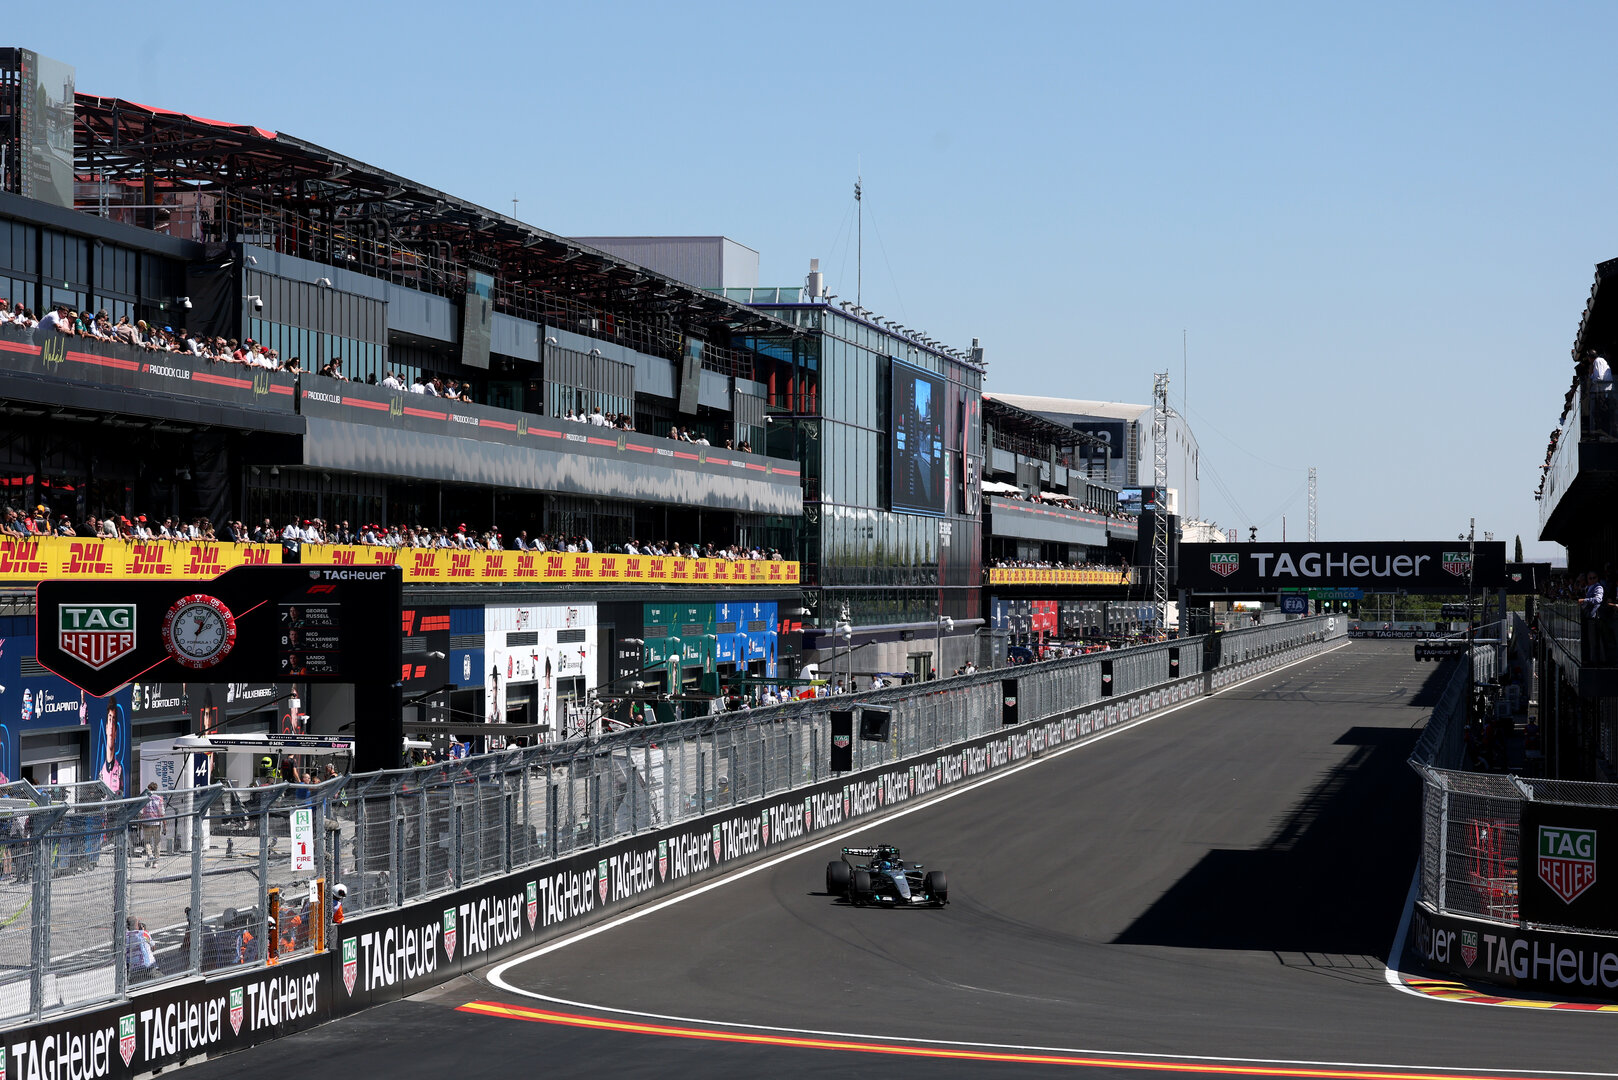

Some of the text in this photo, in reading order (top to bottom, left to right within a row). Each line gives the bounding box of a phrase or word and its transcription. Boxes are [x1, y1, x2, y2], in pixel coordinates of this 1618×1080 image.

[150, 364, 176, 378] PADDOCK
[176, 369, 190, 380] CLUB
[308, 391, 329, 402] PADDOCK
[1, 541, 40, 573] DHL
[68, 543, 106, 573] DHL
[131, 545, 166, 574] DHL
[189, 547, 221, 574] DHL
[412, 553, 438, 576] DHL
[1251, 552, 1430, 577] TAGHeuer
[1211, 563, 1238, 575] HEUER
[1285, 600, 1303, 609] FIA
[65, 608, 129, 628] TAG
[281, 613, 288, 621] 7
[63, 634, 131, 664] HEUER
[281, 636, 288, 644] 8
[281, 660, 288, 668] 9
[45, 701, 78, 713] COLAPINTO
[144, 686, 149, 709] 5
[152, 698, 180, 709] BORTOLETO
[1544, 831, 1591, 857] TAG
[1541, 861, 1592, 898] HEUER
[539, 868, 596, 927] TAGHeuer
[460, 892, 524, 957] TAGHeuer
[344, 938, 356, 962] TAG
[1464, 933, 1476, 946] TAG
[361, 920, 440, 991] TAGHeuer
[231, 989, 243, 1006] TAG
[248, 972, 319, 1031] TAGHeuer
[121, 1017, 134, 1035] TAG
[140, 996, 225, 1061] TAGHeuer
